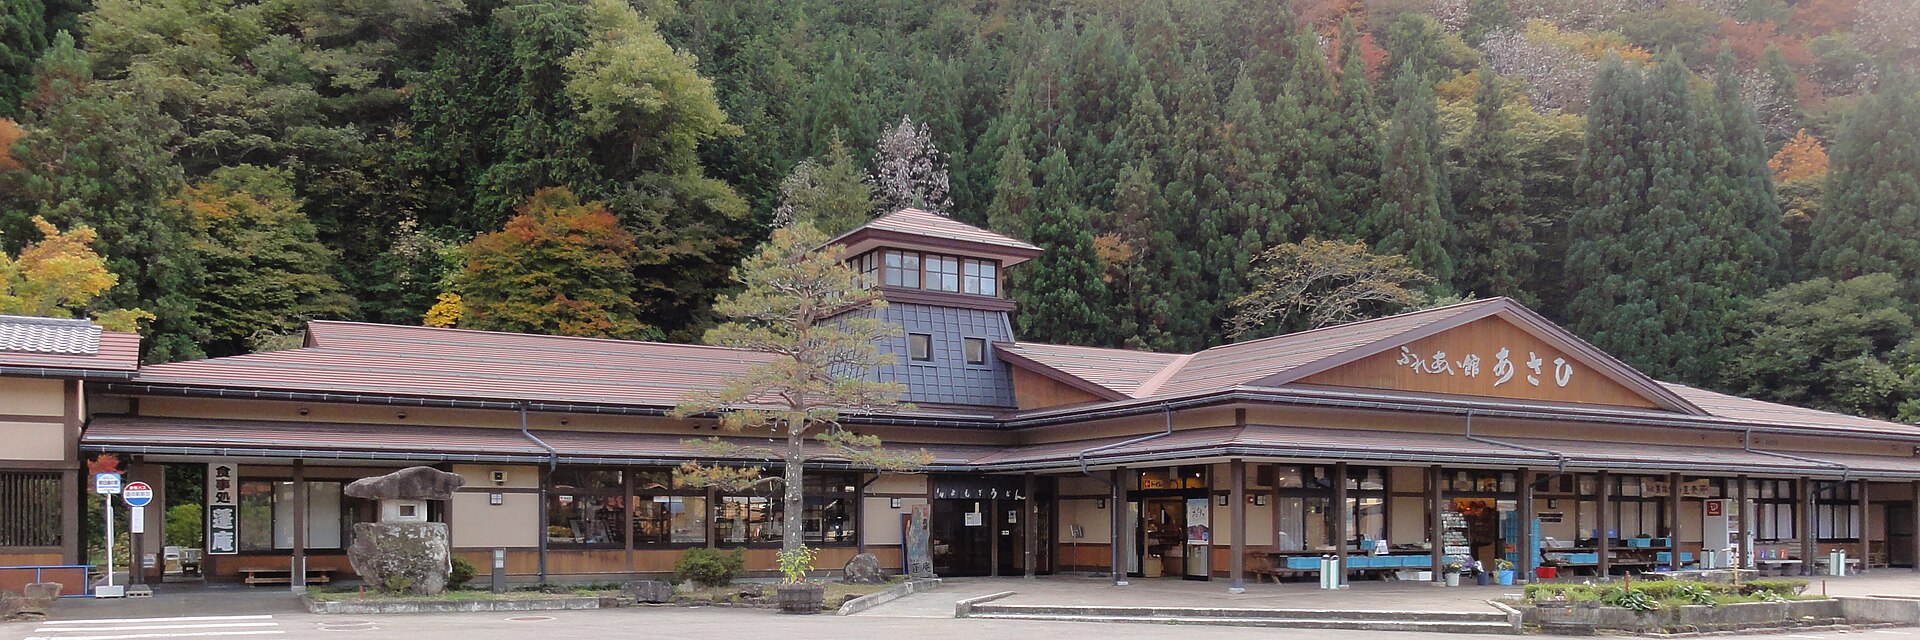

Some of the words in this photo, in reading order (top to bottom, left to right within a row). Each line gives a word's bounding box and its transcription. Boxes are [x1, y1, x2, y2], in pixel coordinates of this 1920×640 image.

[1493, 347, 1573, 387] あさひ
[215, 466, 231, 503] 食事処
